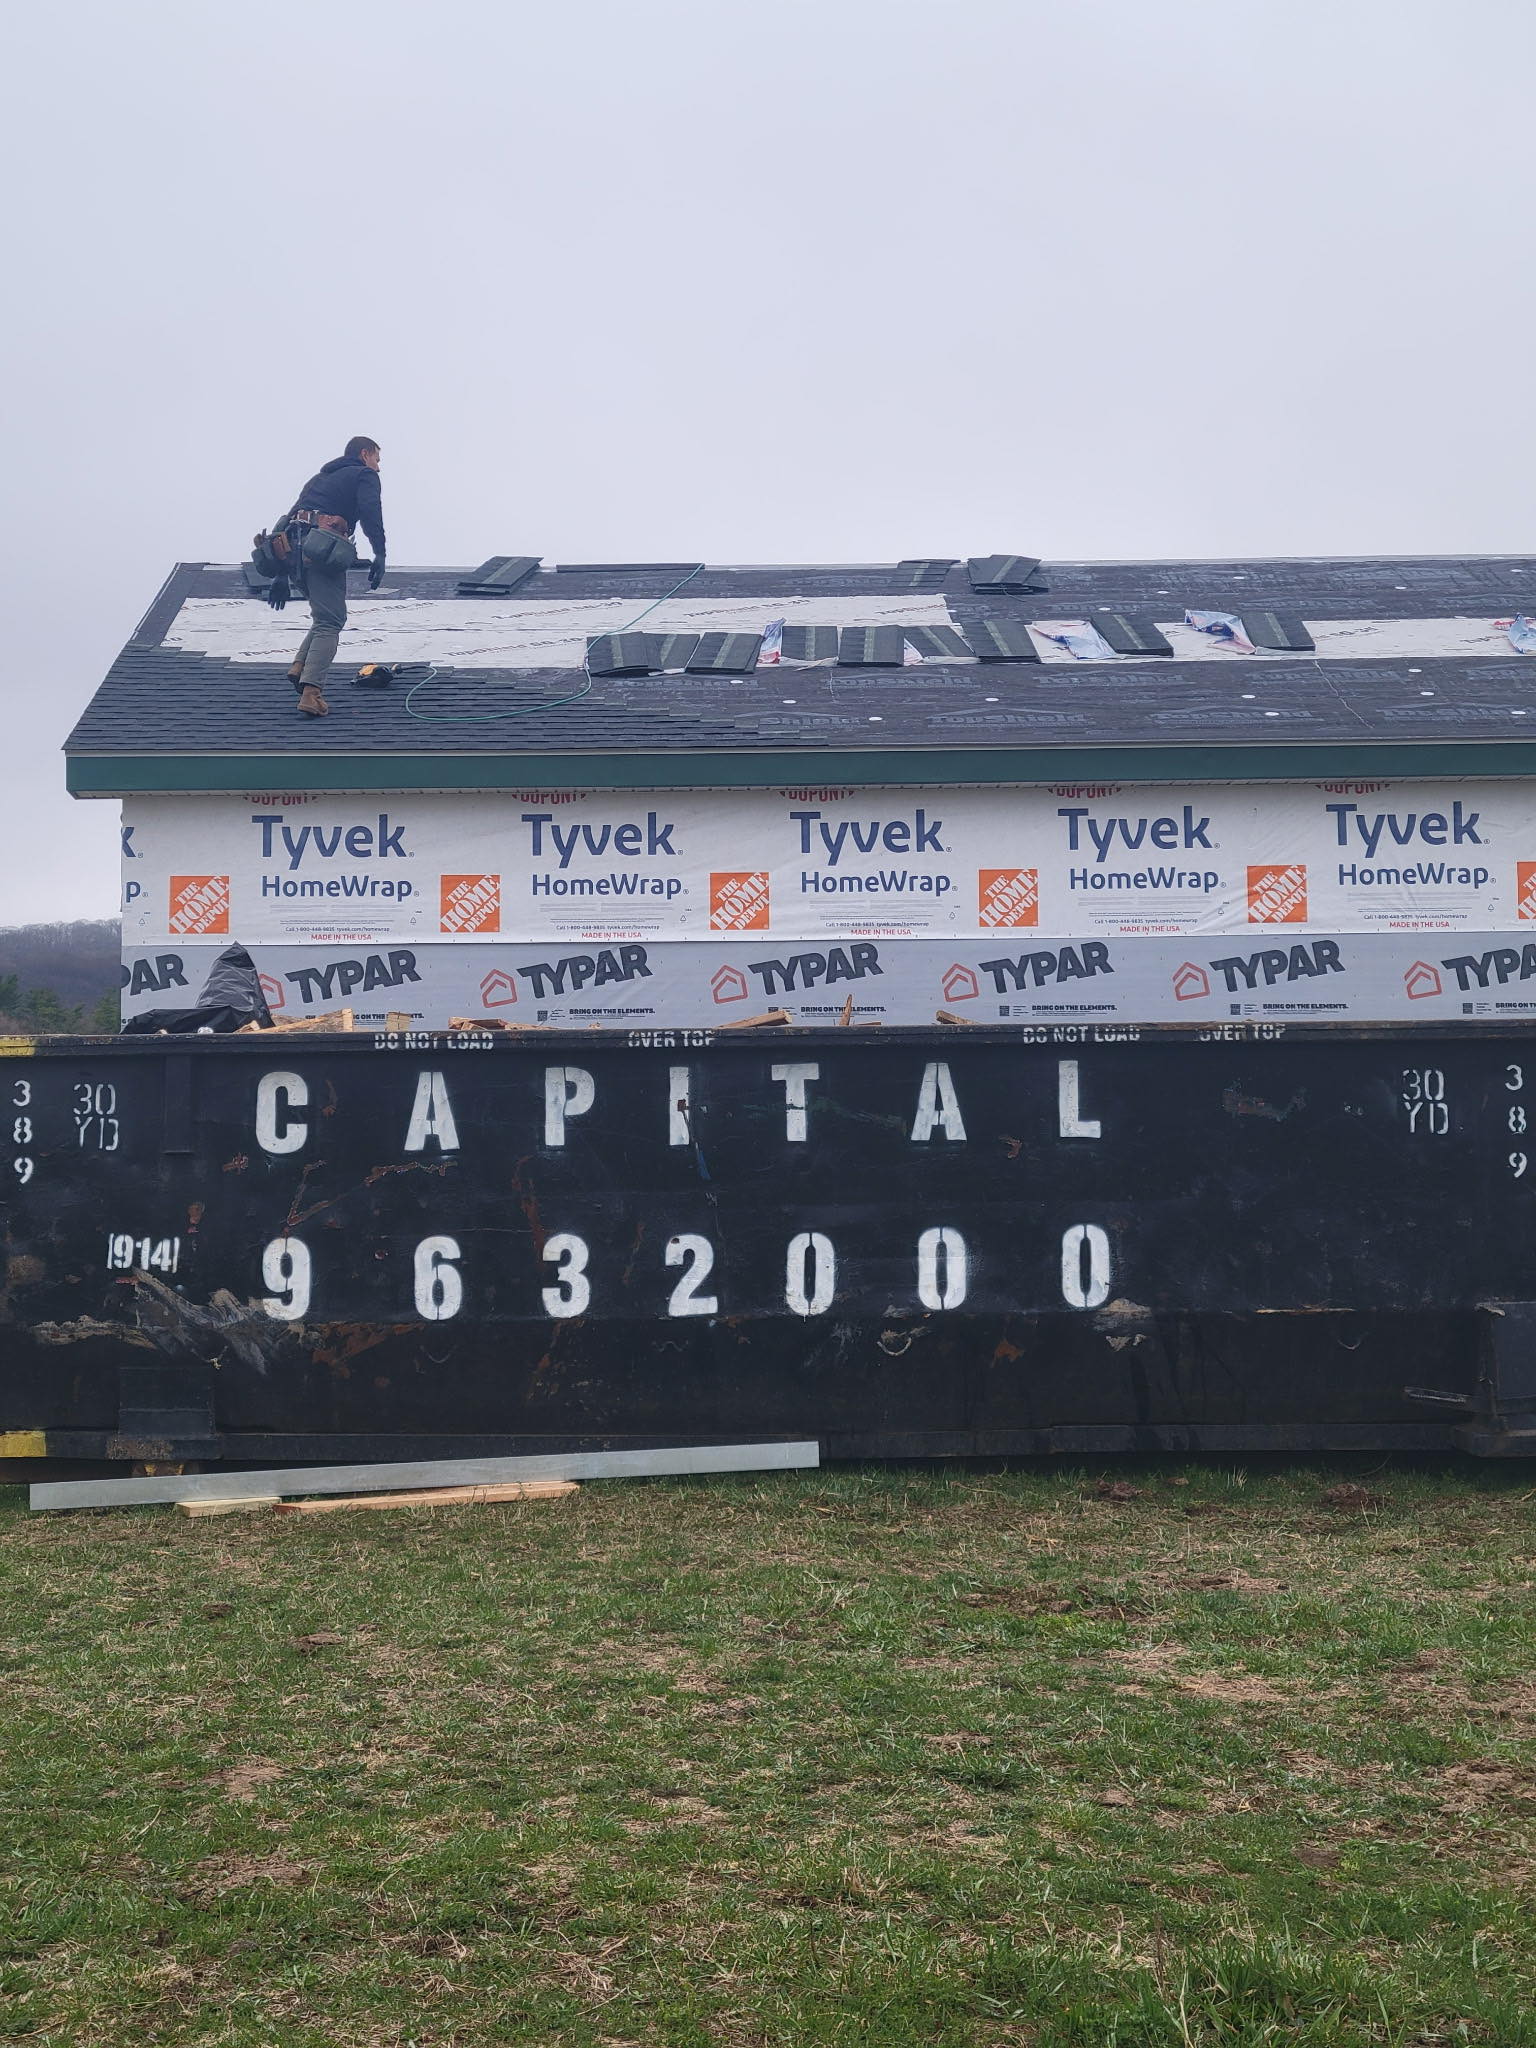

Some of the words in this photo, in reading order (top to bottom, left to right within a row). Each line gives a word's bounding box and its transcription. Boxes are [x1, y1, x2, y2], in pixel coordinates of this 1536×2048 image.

[175, 881, 201, 905] THE
[447, 880, 472, 904] THE
[716, 878, 741, 902] THE
[978, 869, 1038, 928] HOME
[984, 874, 1009, 899] THE
[1247, 865, 1307, 923] HOME
[1252, 871, 1277, 895] THE
[169, 876, 230, 934] HOME
[191, 899, 230, 934] DEPOT
[440, 875, 501, 932] HOME
[463, 899, 501, 932] DEPOT
[709, 872, 769, 930] HOME
[732, 894, 769, 930] DEPOT
[1000, 892, 1038, 928] DEPOT
[1271, 887, 1308, 923] DEPOT
[284, 949, 423, 1004] TYPAR
[516, 944, 654, 999] TYPAR
[747, 942, 884, 996] TYPAR
[978, 941, 1115, 994] TYPAR
[1209, 939, 1346, 993] TYPAR
[374, 1032, 399, 1049] DO
[405, 1032, 438, 1049] NOT
[446, 1032, 494, 1050] LOAD
[628, 1031, 676, 1048] OVER
[680, 1030, 716, 1047] TOP
[1023, 1027, 1048, 1044] DO
[1053, 1025, 1088, 1042] NOT
[1094, 1025, 1140, 1042] LOAD
[1252, 1023, 1286, 1040] TOP
[73, 1083, 116, 1115] 30
[1402, 1069, 1445, 1100] 30
[74, 1116, 119, 1150] YD
[1404, 1102, 1449, 1135] YD
